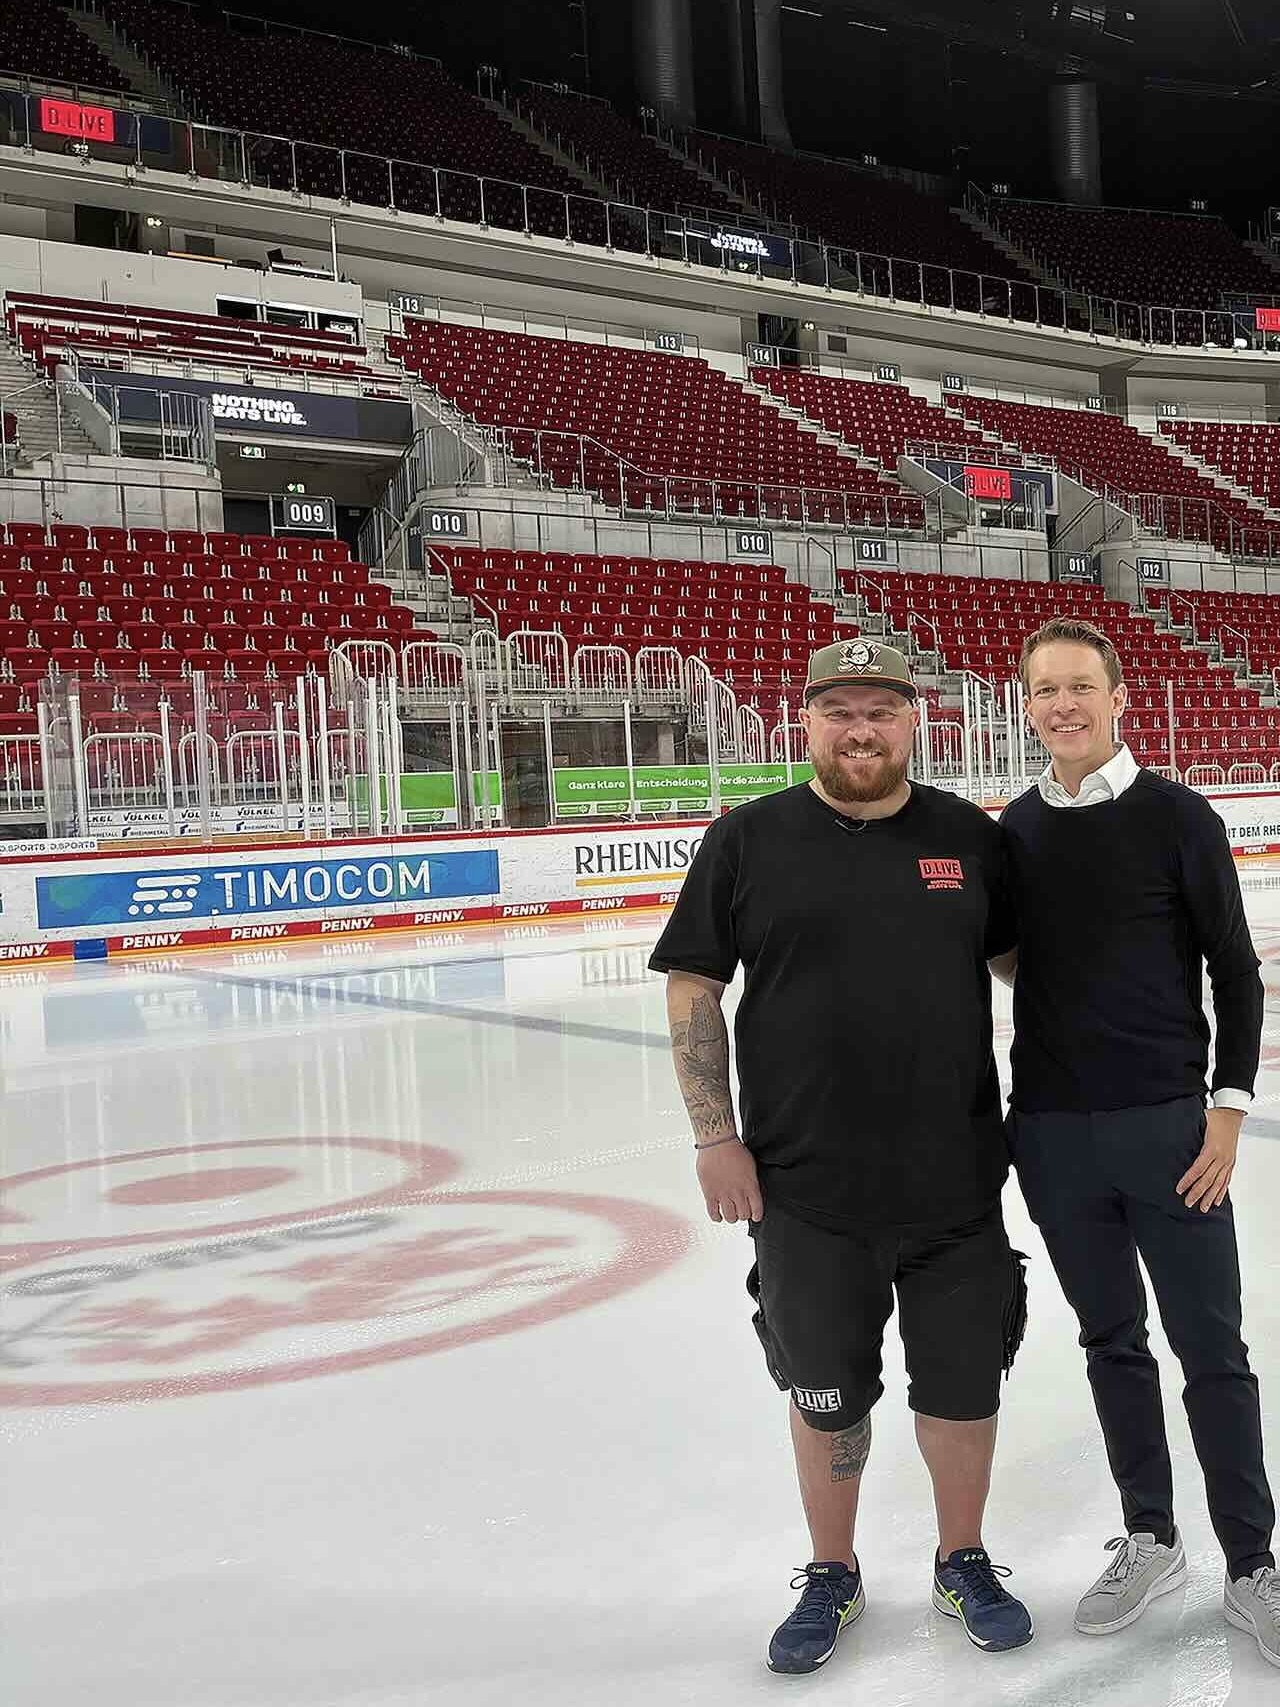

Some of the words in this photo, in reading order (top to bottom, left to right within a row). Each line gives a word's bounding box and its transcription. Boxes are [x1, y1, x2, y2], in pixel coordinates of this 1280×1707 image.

[398, 296, 419, 313] 113
[658, 335, 676, 349] 113
[753, 349, 769, 362] 114
[880, 367, 895, 380] 114
[946, 375, 961, 388] 115
[212, 393, 295, 414] NOTHING
[1088, 396, 1101, 409] 115
[1163, 405, 1177, 416] 116
[290, 503, 325, 523] 009
[431, 514, 461, 533] 010
[741, 535, 764, 551] 010
[862, 542, 882, 558] 011
[1069, 557, 1086, 572] 011
[1143, 563, 1159, 576] 012
[568, 781, 596, 790] Ganz
[637, 777, 708, 791] Entscheidung
[1240, 824, 1260, 840] DEM
[922, 862, 961, 876] D.LIVE
[214, 860, 431, 909] TIMOCOM
[503, 904, 550, 917] PENNY.
[582, 898, 626, 911] PENNY.
[415, 908, 465, 924] PENNY.
[231, 925, 288, 940] PENNY.
[321, 917, 375, 933] PENNY.
[122, 932, 184, 949] PENNY.
